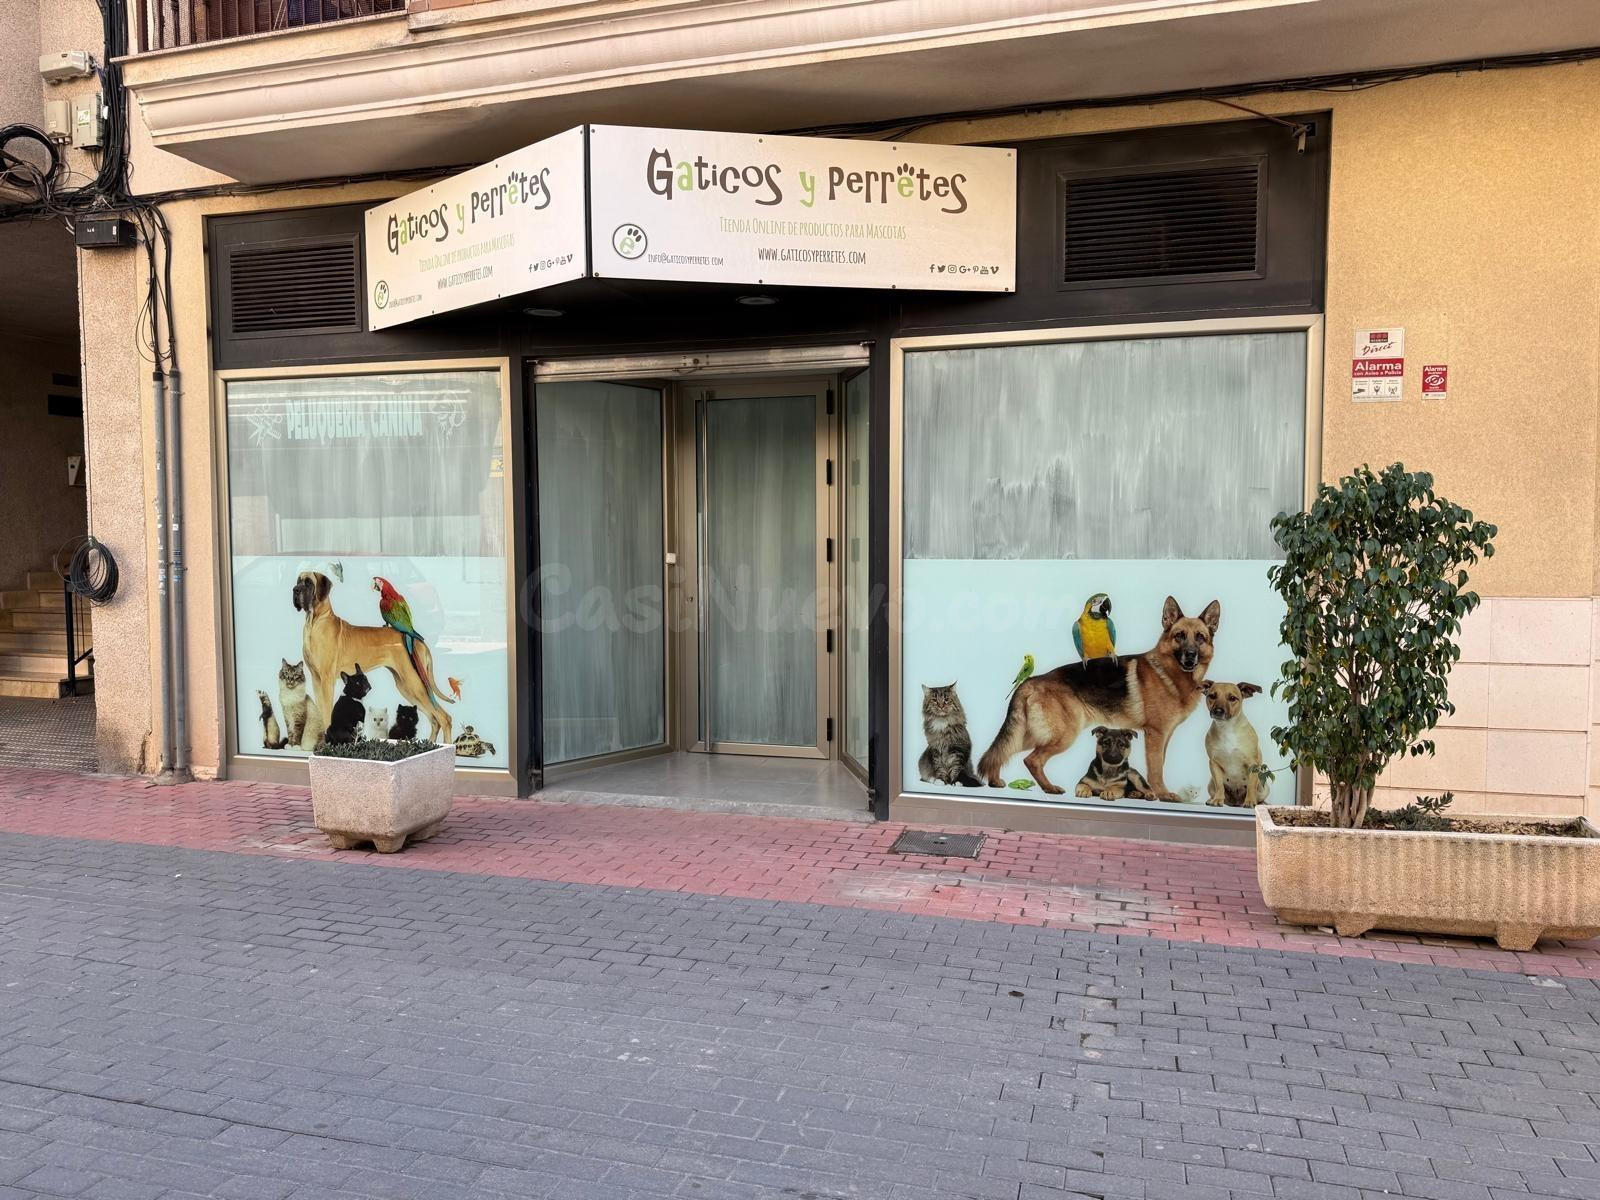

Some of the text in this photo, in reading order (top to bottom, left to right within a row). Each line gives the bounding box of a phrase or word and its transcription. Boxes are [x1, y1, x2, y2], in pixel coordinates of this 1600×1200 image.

[387, 167, 551, 255] Gaticos y Perretes
[647, 147, 968, 214] Gaticos y Perretes
[1354, 361, 1402, 371] Alarma
